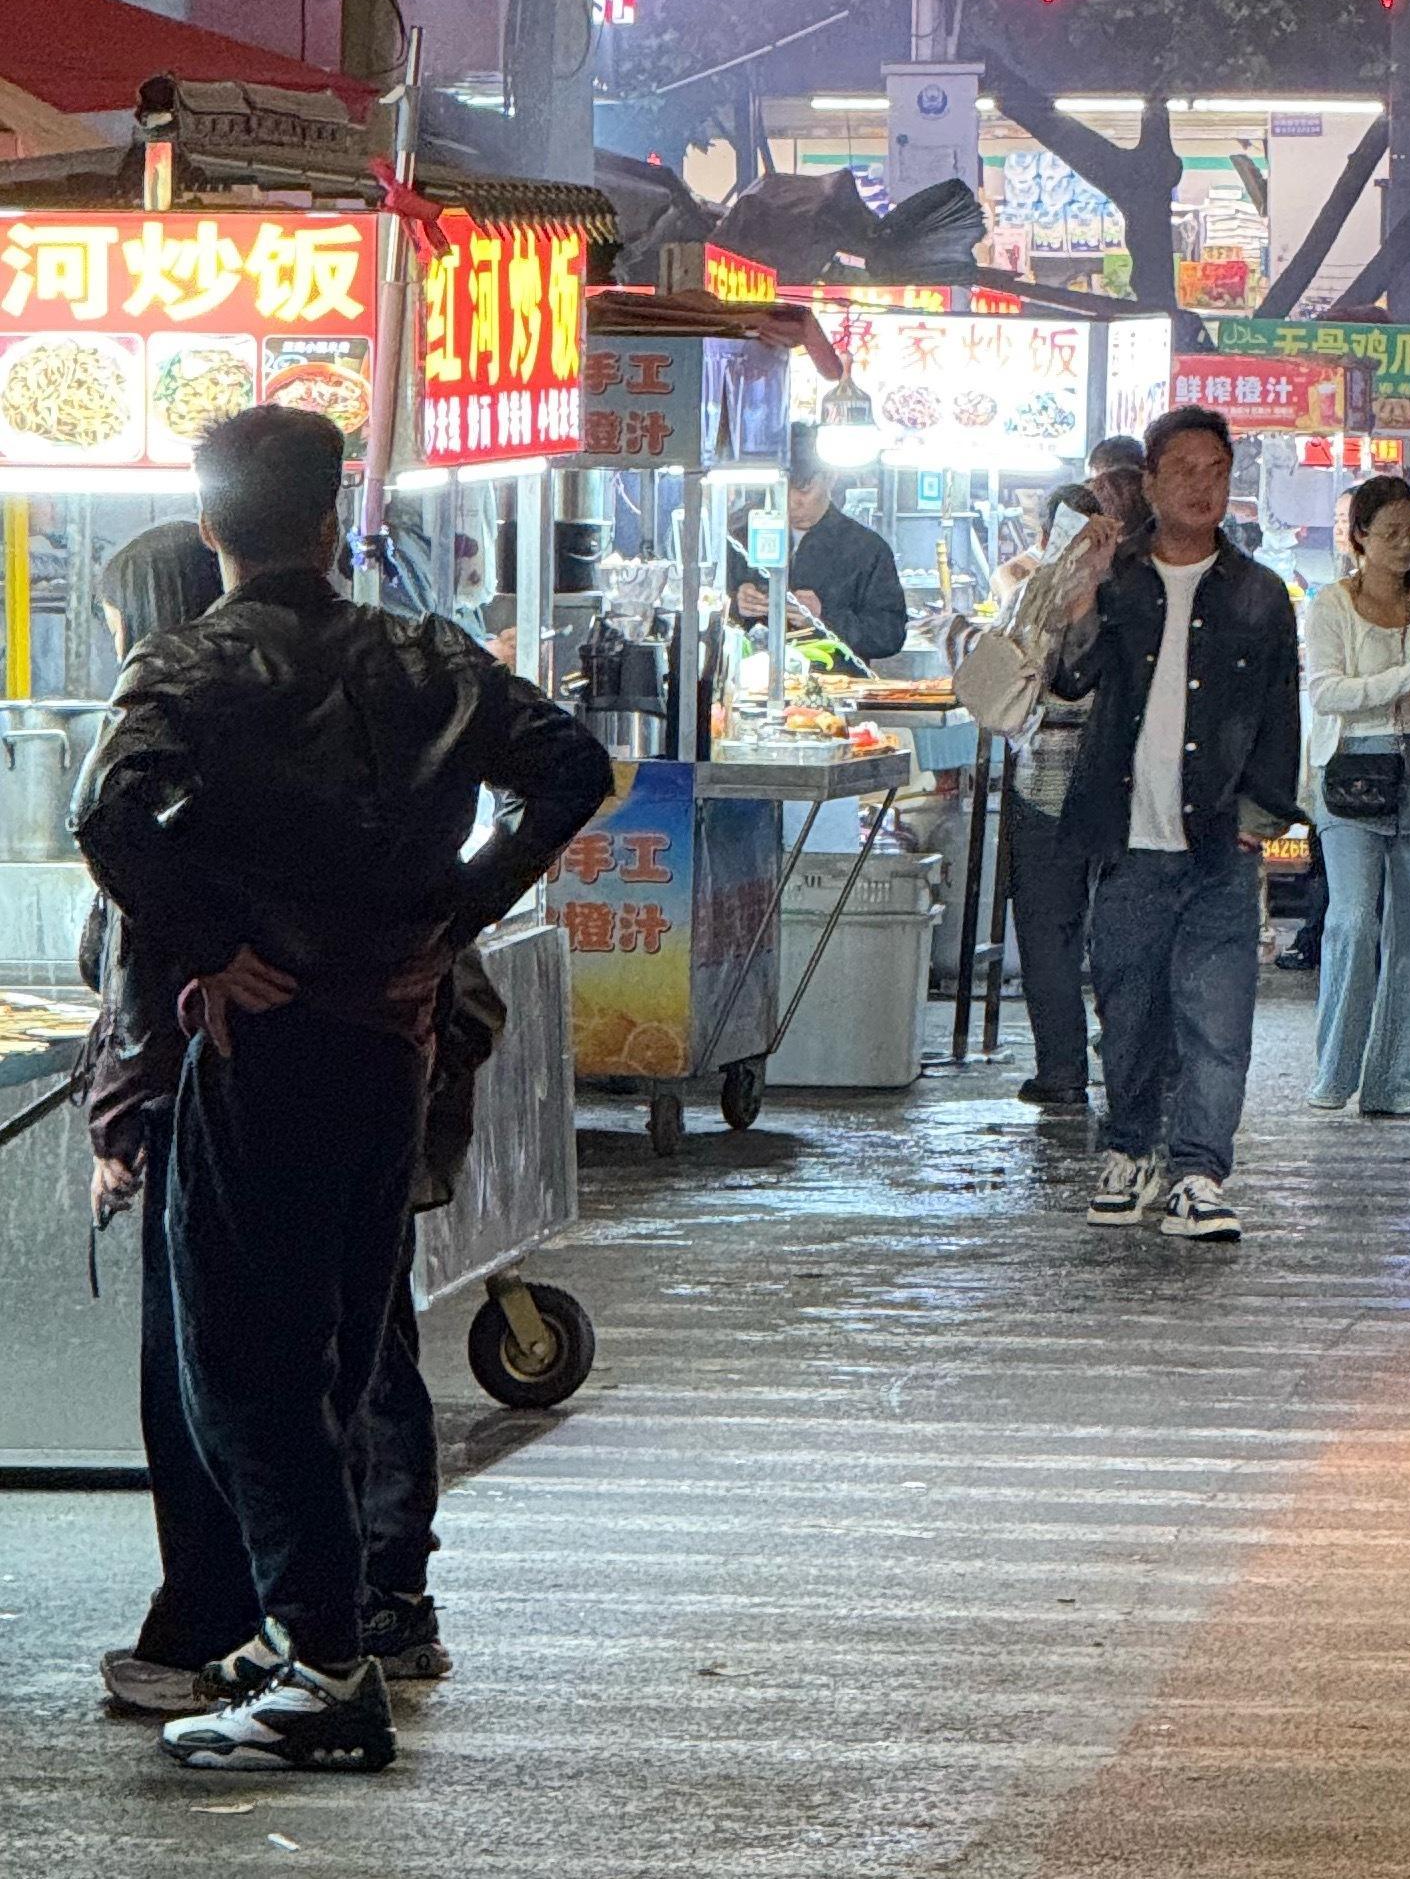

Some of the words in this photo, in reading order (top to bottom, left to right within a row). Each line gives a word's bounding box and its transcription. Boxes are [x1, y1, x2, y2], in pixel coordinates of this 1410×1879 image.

[1, 221, 365, 321] 河炒饭
[425, 227, 580, 386] 红河炒饭
[1175, 376, 1293, 404] 鲜榨橙汁
[547, 832, 672, 884] 手工
[546, 903, 672, 954] 橙汁
